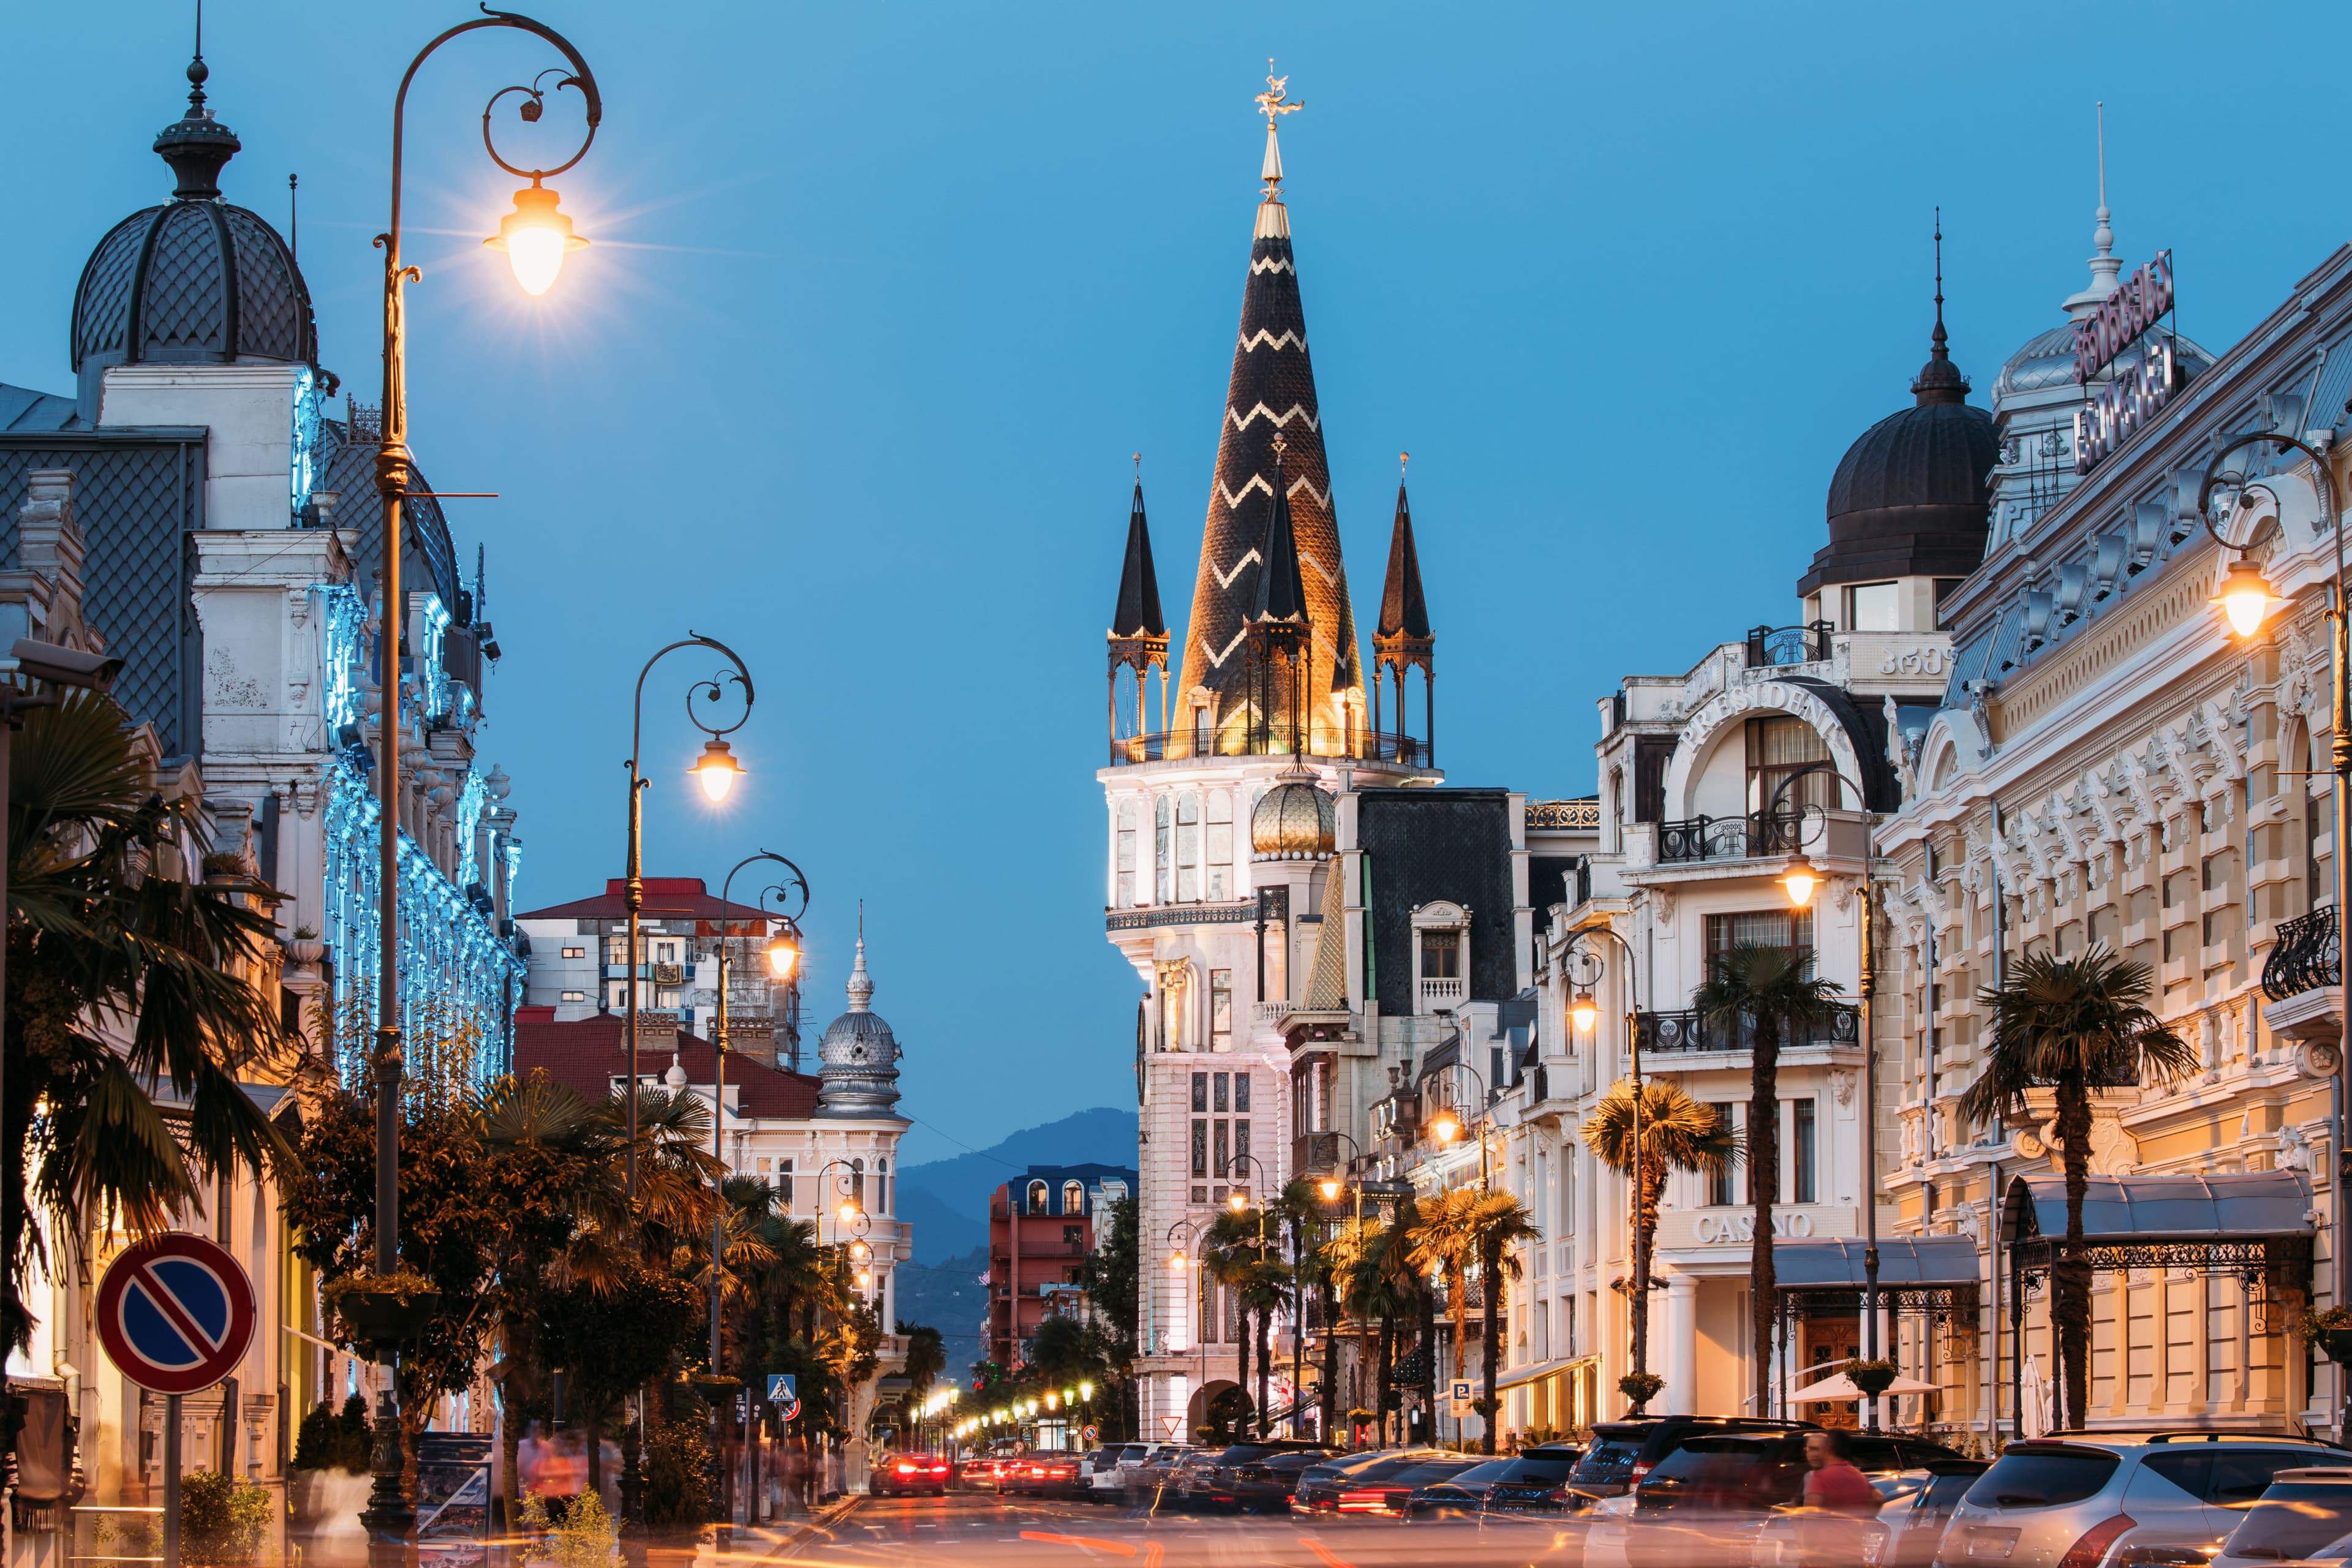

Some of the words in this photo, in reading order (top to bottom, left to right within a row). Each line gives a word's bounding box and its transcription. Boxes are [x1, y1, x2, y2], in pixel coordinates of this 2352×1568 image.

[1678, 682, 1842, 754] PRESIDENT
[1694, 1212, 1814, 1243] CASNO
[1457, 1385, 1466, 1398] P
